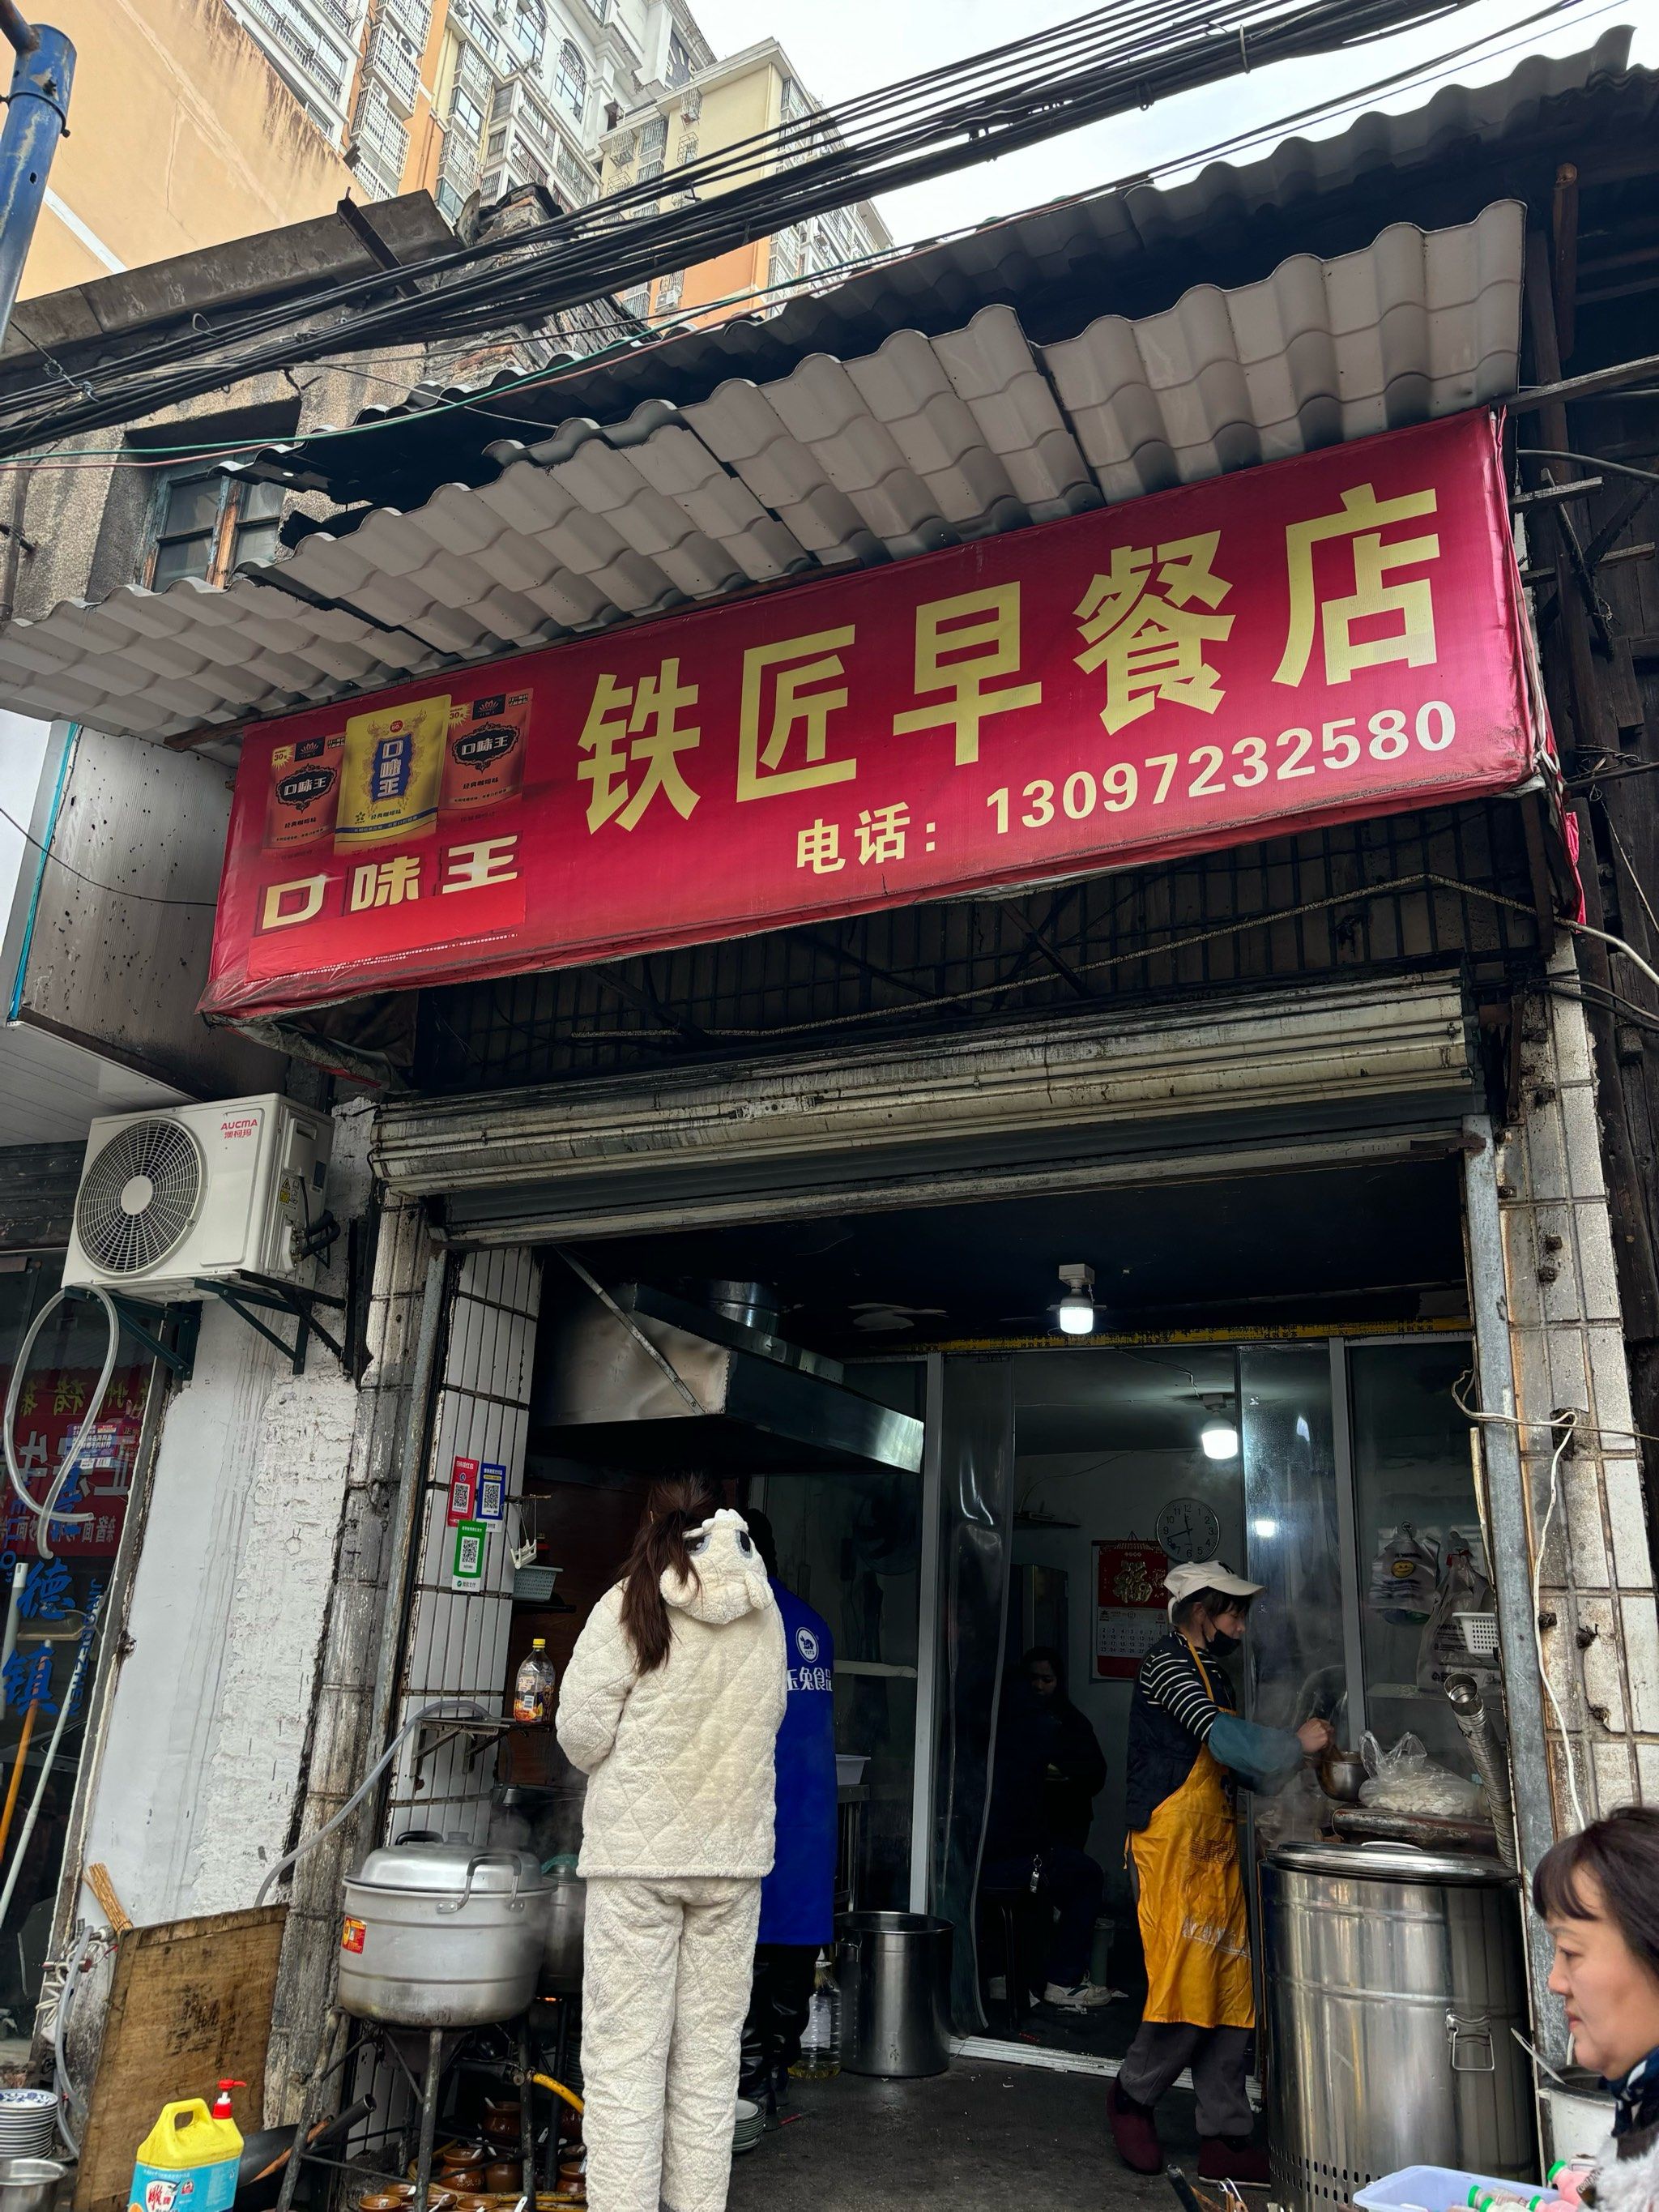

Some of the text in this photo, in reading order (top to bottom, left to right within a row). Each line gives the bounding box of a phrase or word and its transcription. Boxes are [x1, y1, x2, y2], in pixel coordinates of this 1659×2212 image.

[578, 483, 1440, 835] 铁匠早餐店
[377, 740, 403, 797] 口味王
[462, 735, 509, 755] 口味王
[987, 700, 1456, 835] 13097232580
[284, 776, 326, 796] 口味王
[262, 835, 518, 929] 口味王
[220, 1119, 258, 1130] AUCMA
[68, 1578, 104, 1715] JINGDEZHEN
